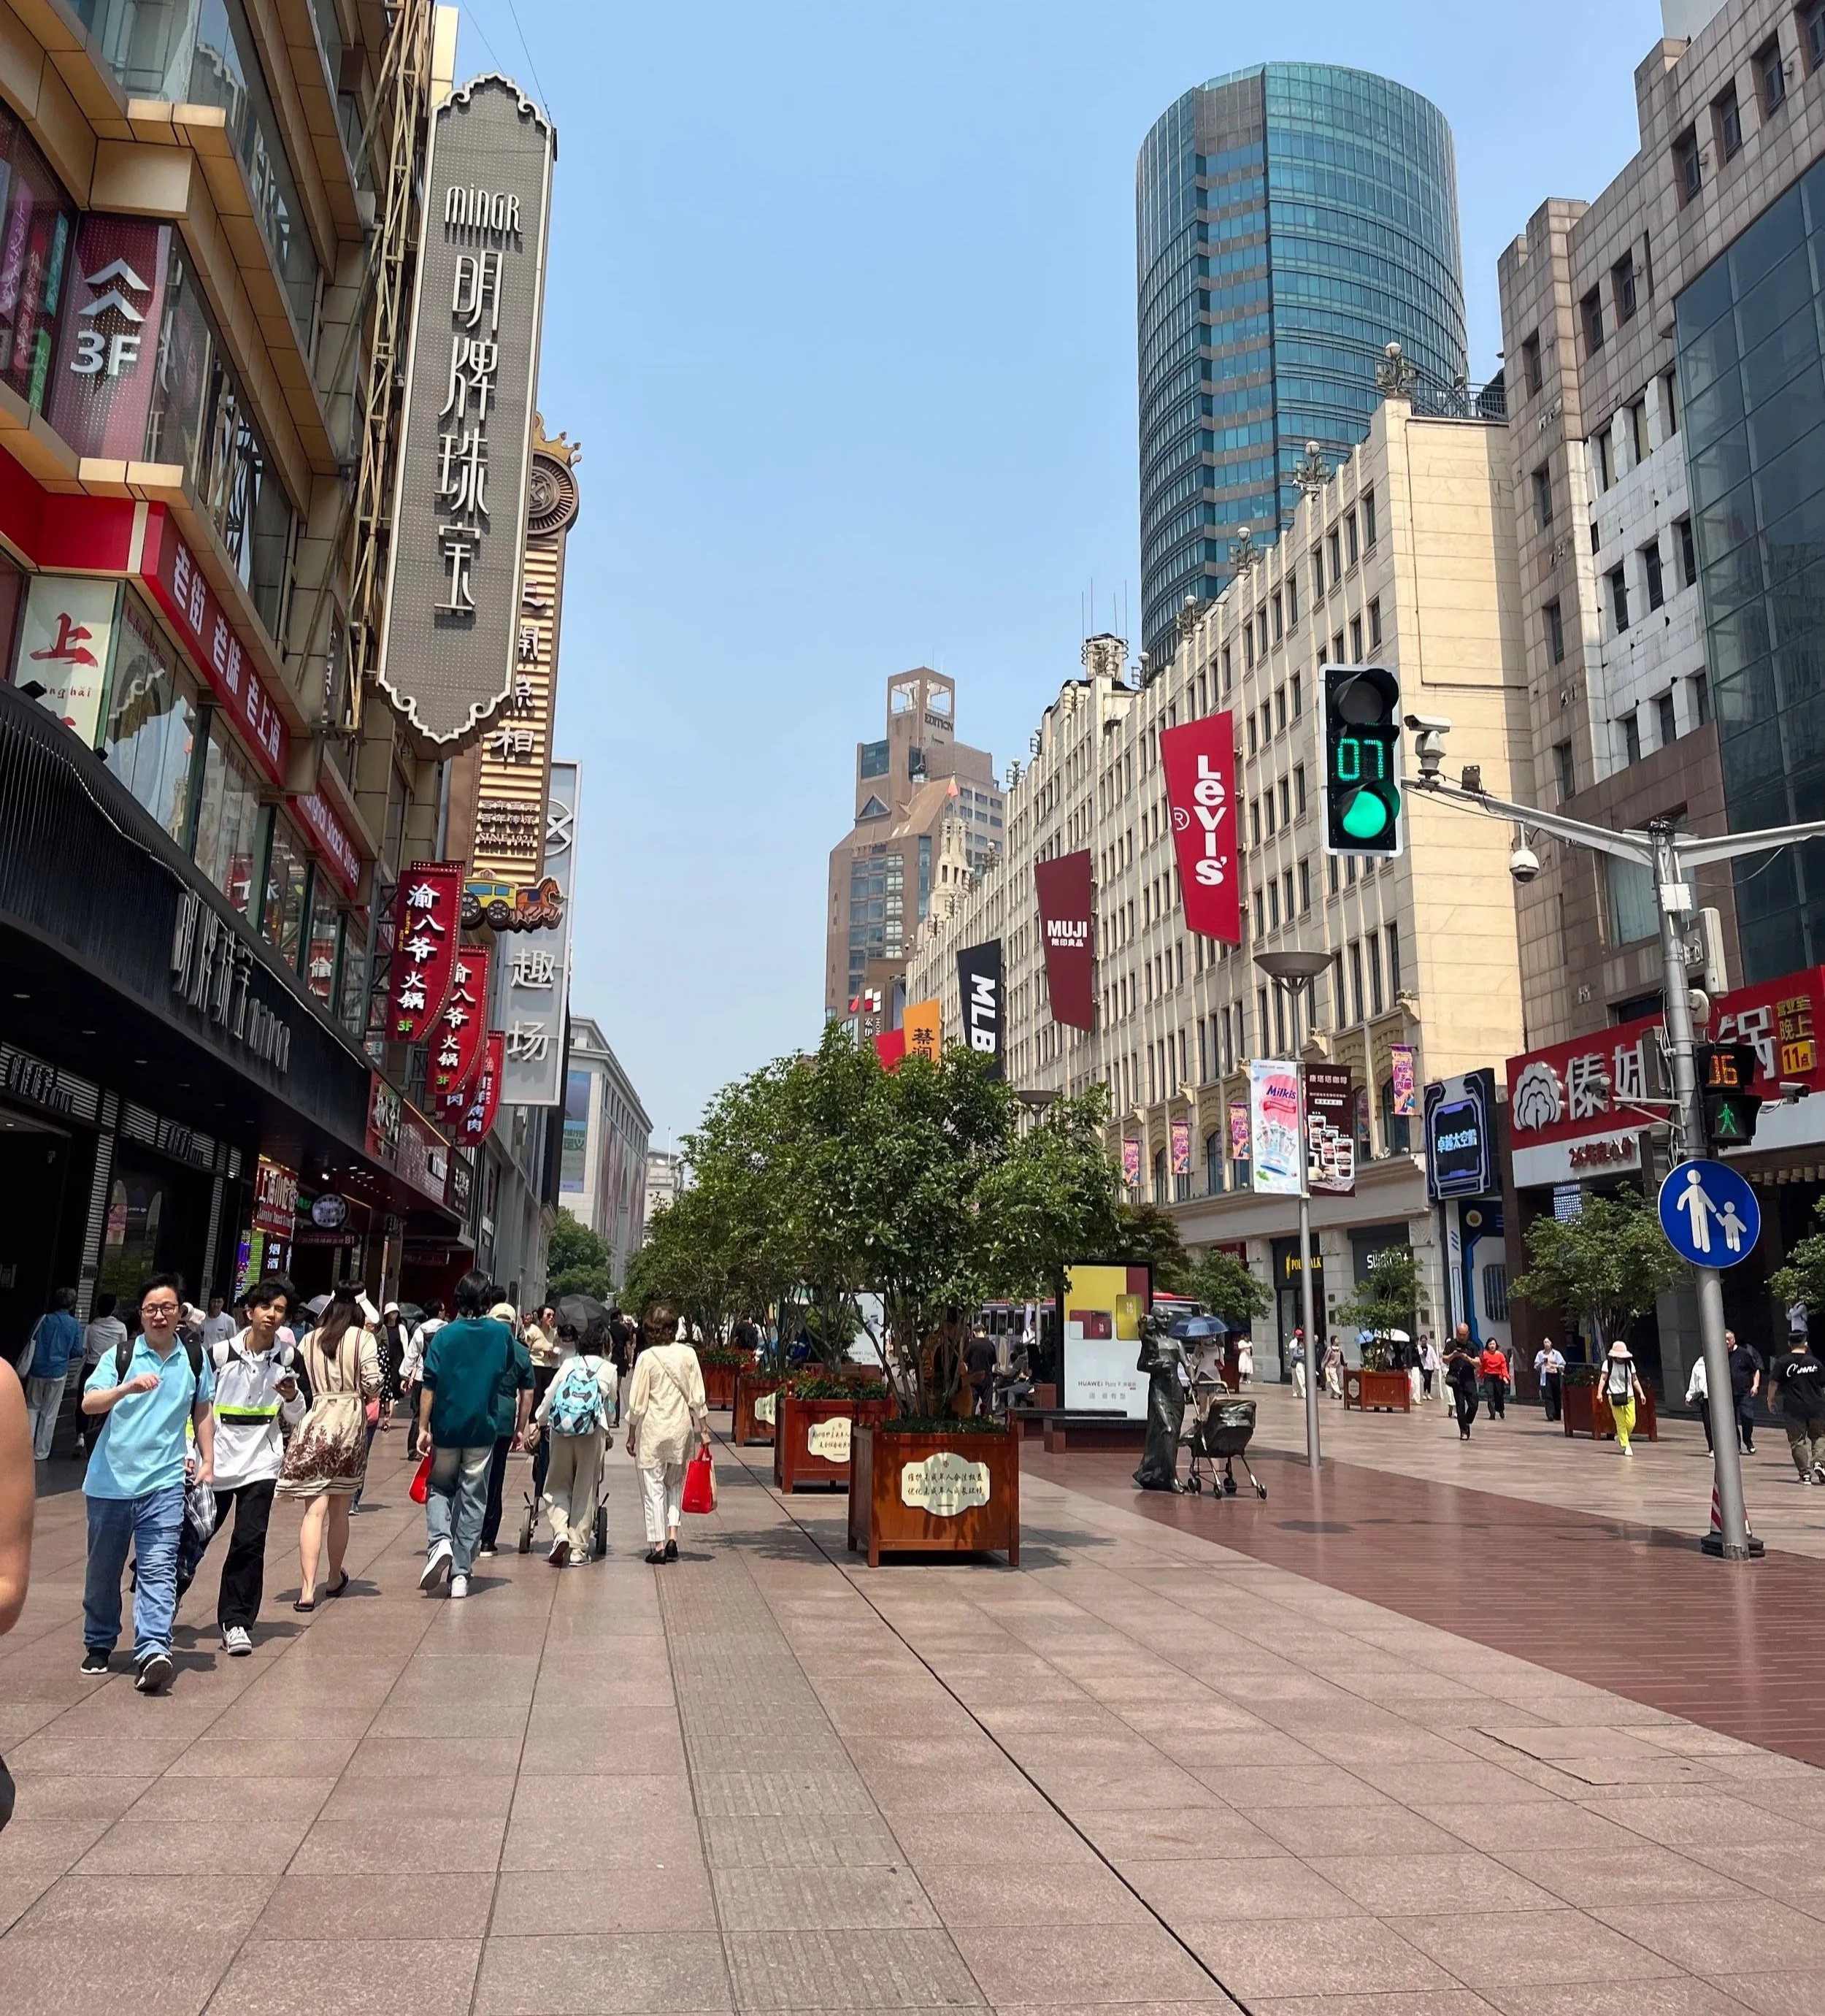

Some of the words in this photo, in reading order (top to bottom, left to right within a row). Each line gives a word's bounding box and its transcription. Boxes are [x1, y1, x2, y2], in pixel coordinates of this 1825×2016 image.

[71, 331, 140, 375] 3F
[434, 250, 504, 610] 明牌珠宝
[173, 543, 205, 635] 老街
[30, 613, 98, 668] 上
[924, 713, 953, 732] EDITION
[1338, 737, 1383, 780] 07
[510, 835, 534, 844] 1921
[1047, 920, 1088, 938] MUJI
[396, 883, 445, 1010] 渝八爷火锅
[1051, 938, 1084, 947] 無印良品
[971, 973, 996, 1054] MLB
[1777, 995, 1813, 1017] 营业至
[1779, 1015, 1815, 1041] 晚上
[1783, 1046, 1810, 1070] 11点
[436, 1075, 450, 1085] 3F
[1266, 1085, 1296, 1100] Milkis
